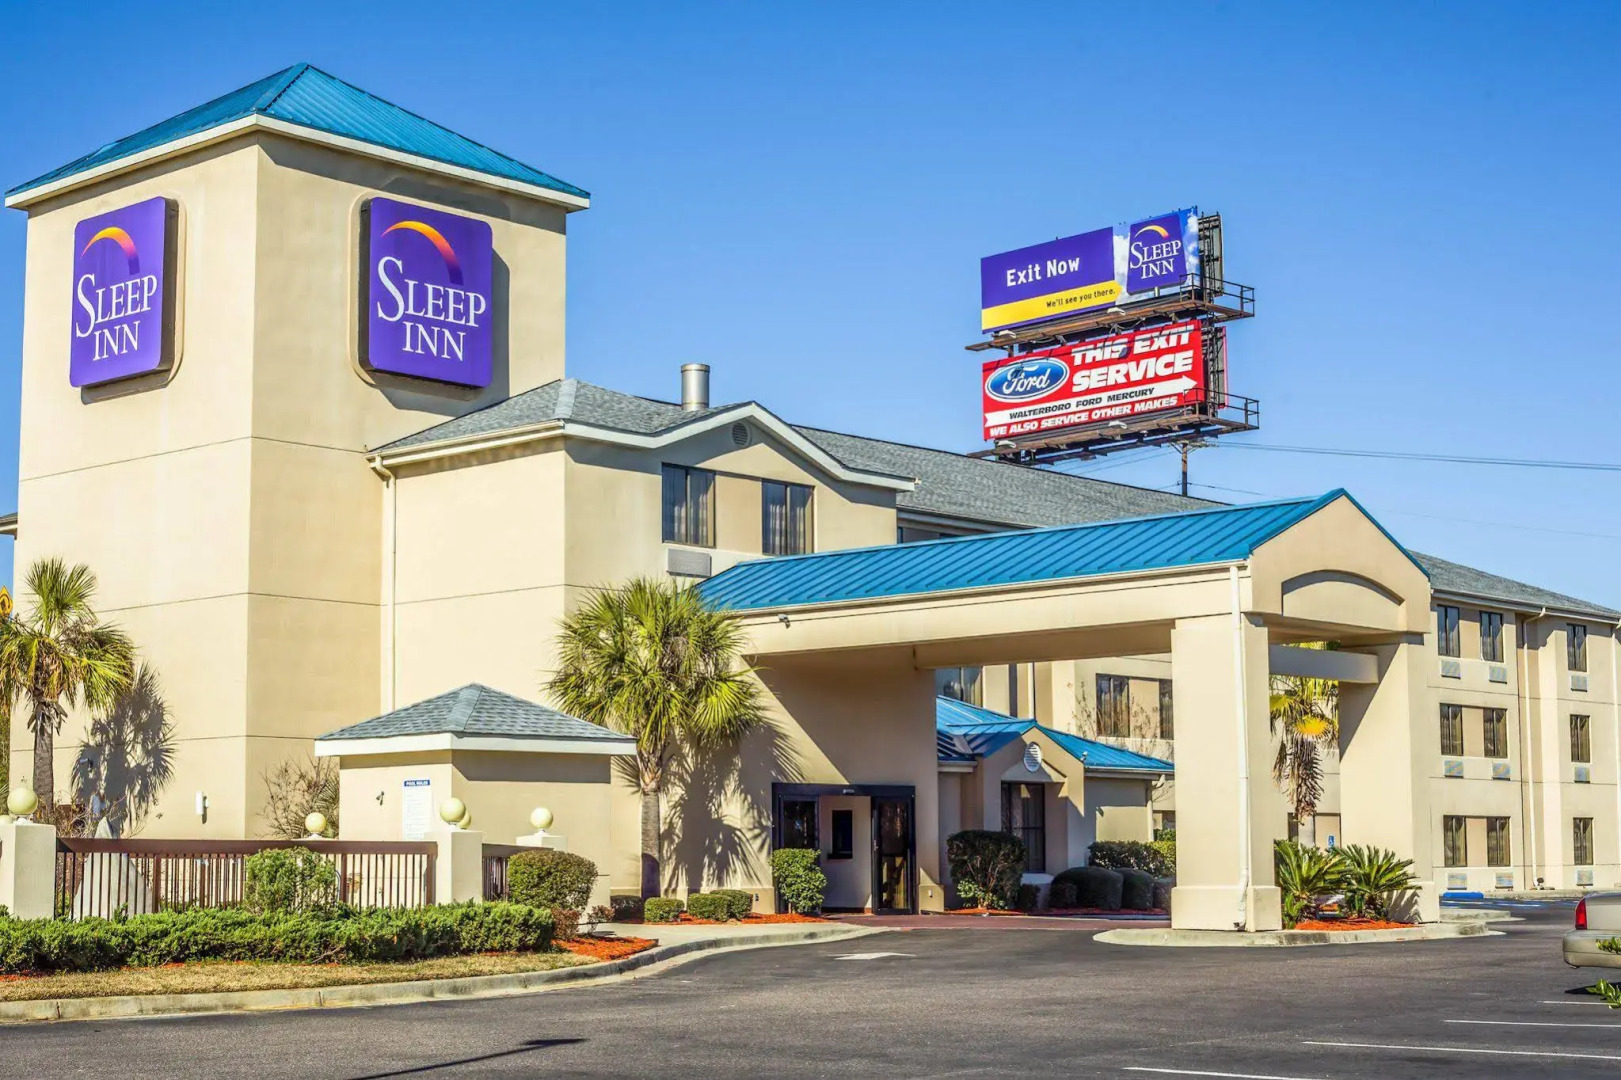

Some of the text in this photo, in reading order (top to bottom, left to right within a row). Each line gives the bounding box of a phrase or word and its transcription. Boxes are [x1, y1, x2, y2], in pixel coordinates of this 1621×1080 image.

[1006, 257, 1080, 287] Exit Now
[1130, 239, 1181, 269] SLEEP
[1140, 258, 1174, 279] INN
[76, 273, 158, 338] SLEEP
[377, 256, 486, 328] SLEEP
[1046, 288, 1116, 309] We'll see you there.
[92, 320, 141, 362] INN
[402, 321, 466, 362] INN
[1071, 324, 1194, 366] THIS EXIT
[1002, 364, 1051, 395] Ford
[1072, 350, 1194, 393] SERVICE
[989, 396, 1178, 437] WE ALSO SERVICE OTHER MAKES
[1009, 387, 1155, 420] WALTERBORO FORD MERCURY
